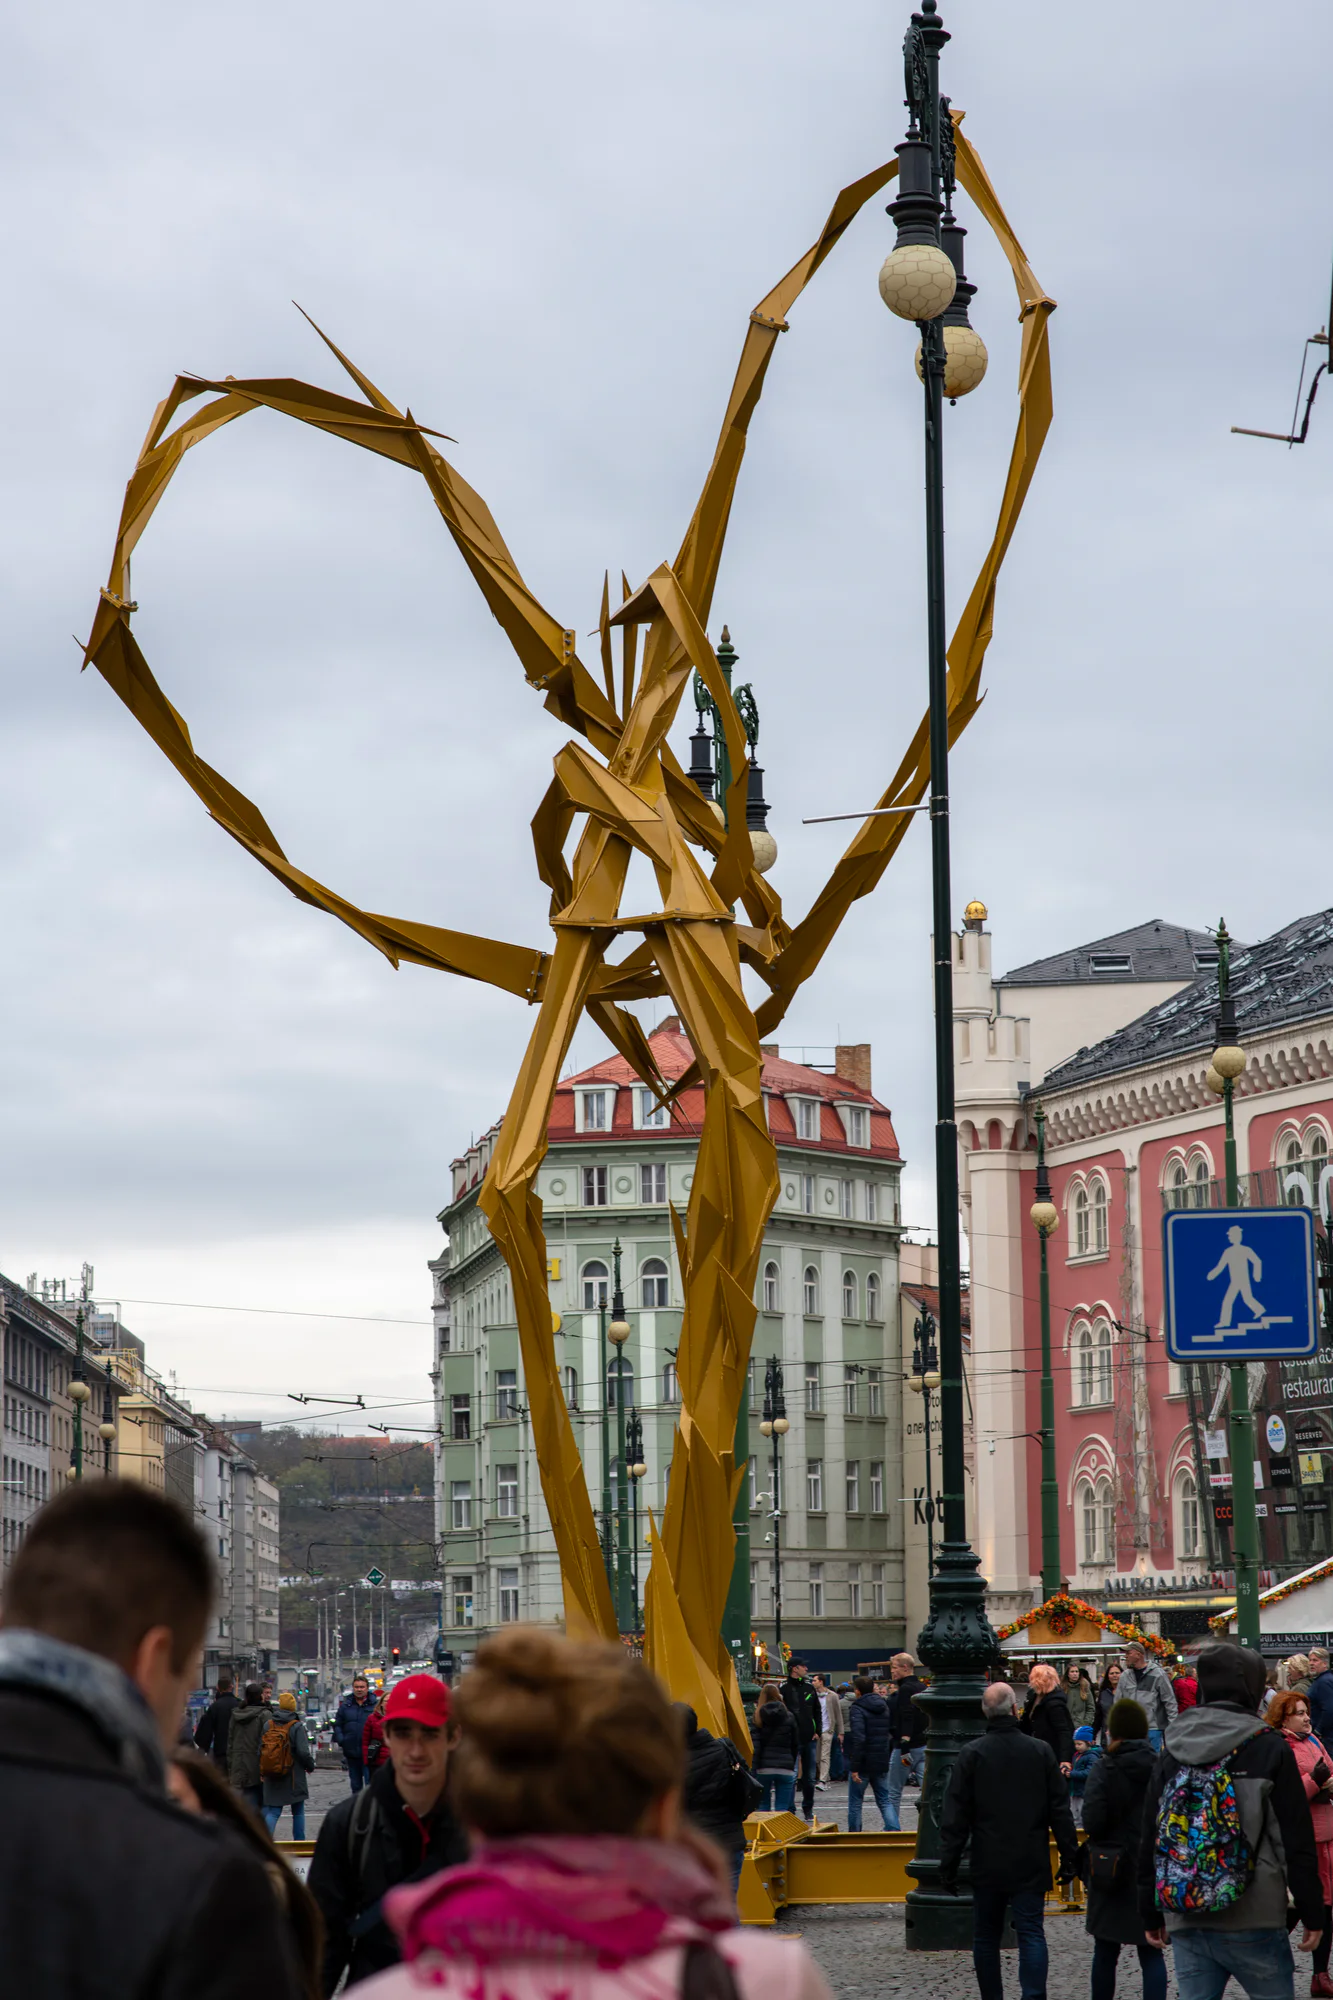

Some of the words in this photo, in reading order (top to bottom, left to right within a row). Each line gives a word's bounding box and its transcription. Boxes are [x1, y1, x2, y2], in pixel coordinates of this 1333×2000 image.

[1295, 1431, 1323, 1440] RESERVED
[1271, 1468, 1291, 1476] SEPHORA
[1215, 1506, 1233, 1519] CCC
